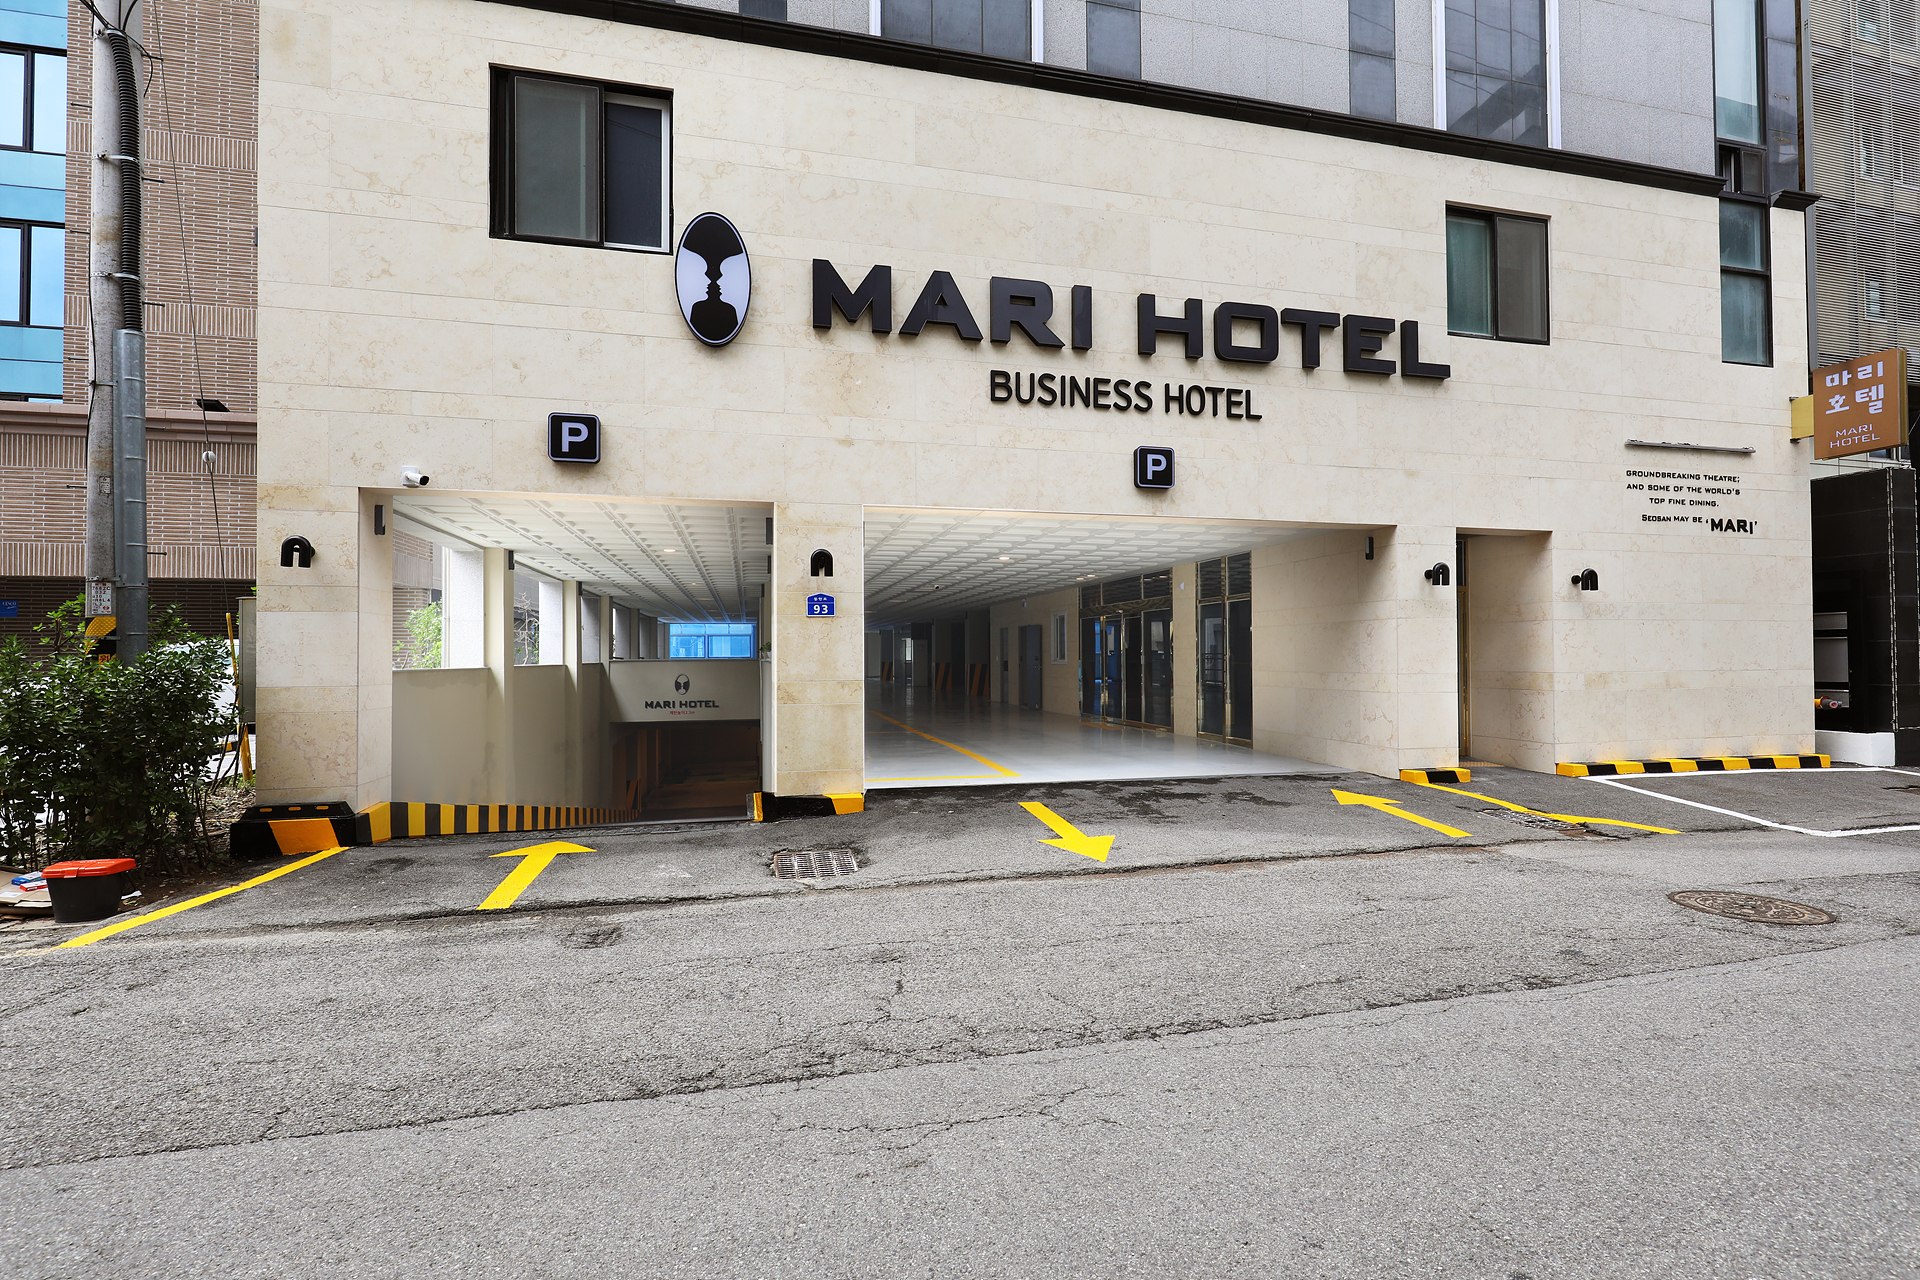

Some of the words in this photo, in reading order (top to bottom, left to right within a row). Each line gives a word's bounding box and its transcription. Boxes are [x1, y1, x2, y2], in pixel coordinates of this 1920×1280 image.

[812, 258, 1092, 351] MARI
[1137, 293, 1451, 380] HOTEL
[1825, 361, 1884, 387] 마리
[990, 370, 1152, 413] BUSINESS
[1165, 382, 1262, 420] HOTEL
[1825, 383, 1884, 415] 호텔
[561, 421, 588, 453] P
[1836, 423, 1873, 437] MARI
[1830, 433, 1880, 449] HOTEL
[1148, 453, 1167, 480] P
[1626, 470, 1701, 480] GROUNDBREAKING
[1704, 487, 1740, 495] WORLD'S
[1689, 499, 1719, 507] DINING.
[1673, 515, 1689, 523] MAY
[813, 604, 829, 614] 93
[644, 700, 675, 709] MARI
[679, 700, 720, 709] HOTEL
